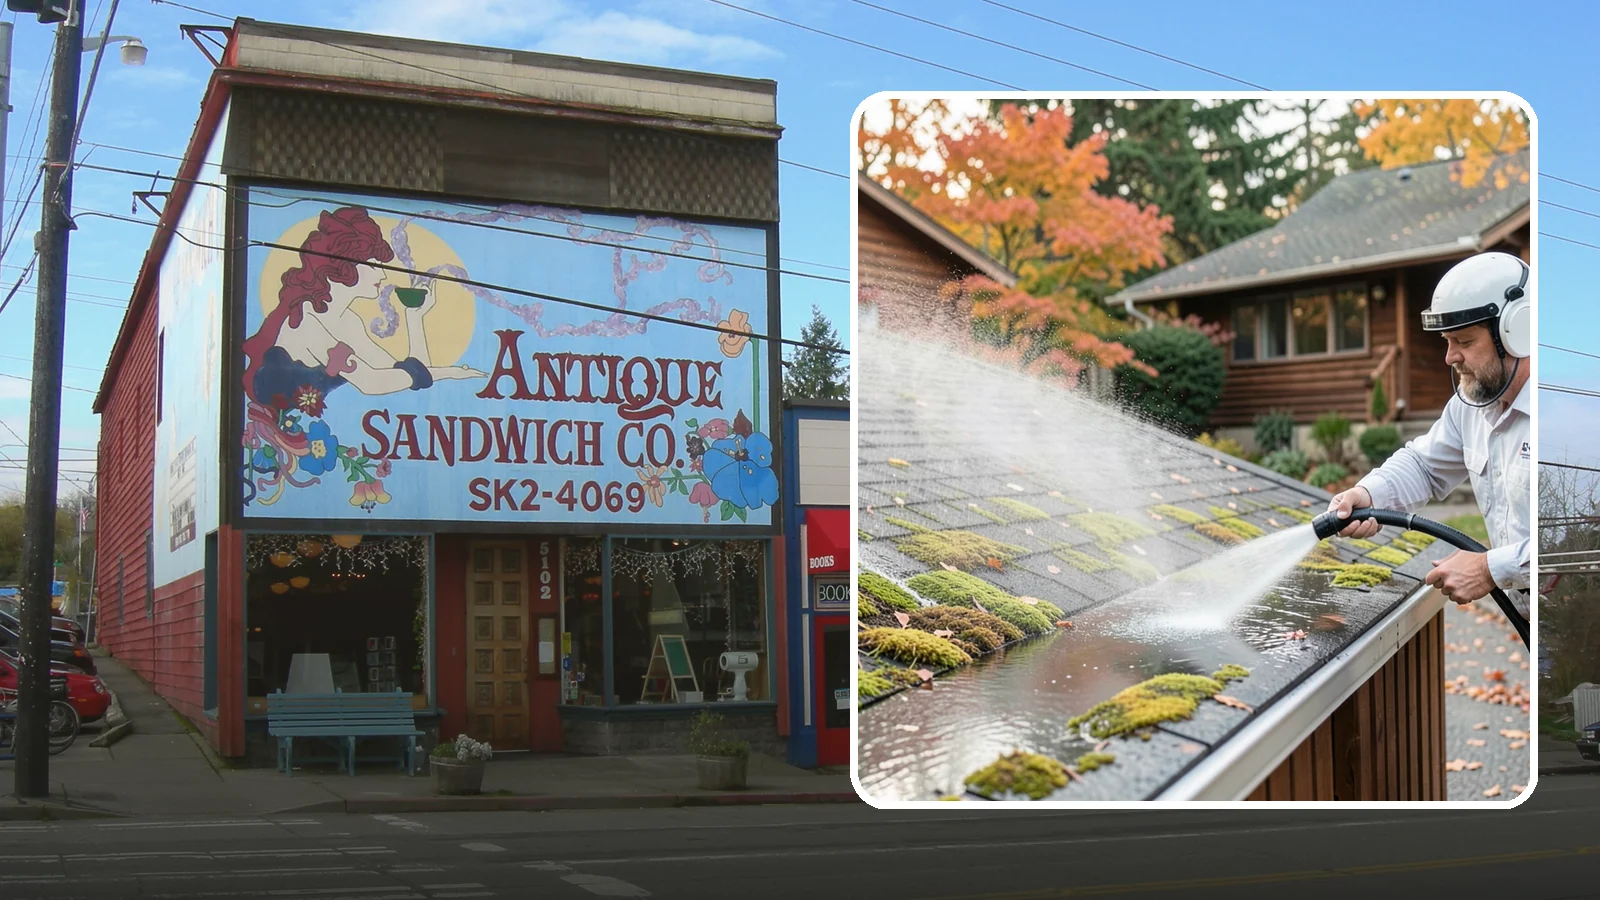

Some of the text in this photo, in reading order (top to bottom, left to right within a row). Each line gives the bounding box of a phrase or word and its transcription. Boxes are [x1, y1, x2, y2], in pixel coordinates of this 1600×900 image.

[476, 329, 723, 420] ANTIQUE
[361, 409, 684, 468] SANDWICH CO.
[468, 477, 645, 513] SK2-4069
[540, 541, 551, 599] 5102
[809, 555, 834, 569] BOOKS
